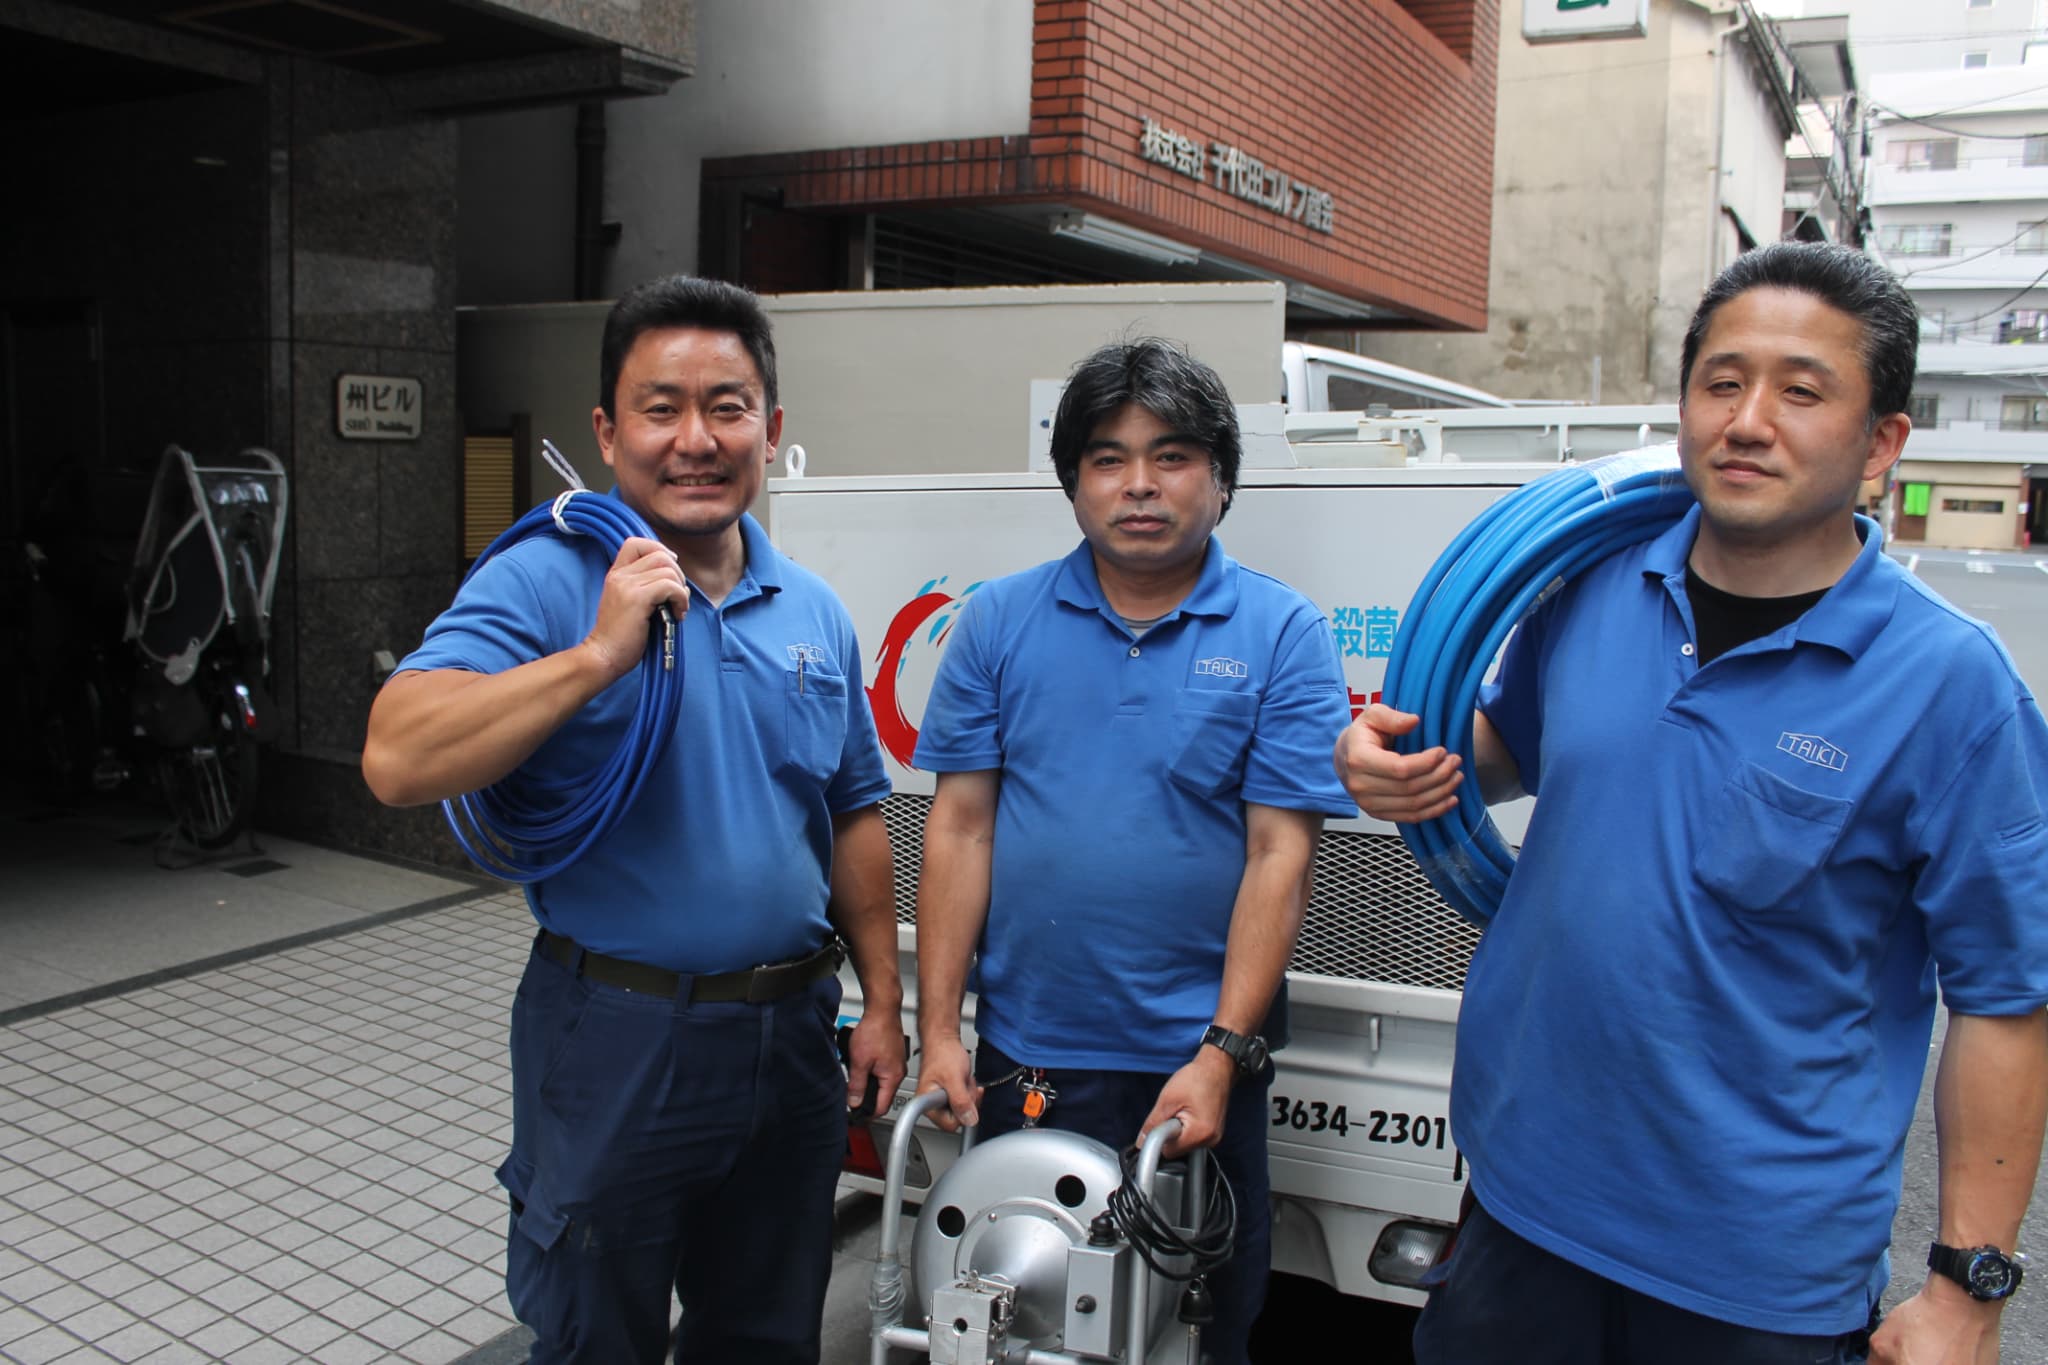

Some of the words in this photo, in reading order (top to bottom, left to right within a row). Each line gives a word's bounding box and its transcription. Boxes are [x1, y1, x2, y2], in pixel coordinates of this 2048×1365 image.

[1140, 114, 1206, 182] 株式会社
[346, 383, 416, 413] 州ビル
[1332, 605, 1399, 660] 殺菌
[1202, 660, 1240, 675] TAIKI
[1788, 735, 1838, 766] TAIKI
[1271, 1095, 1447, 1150] 3634-2301
